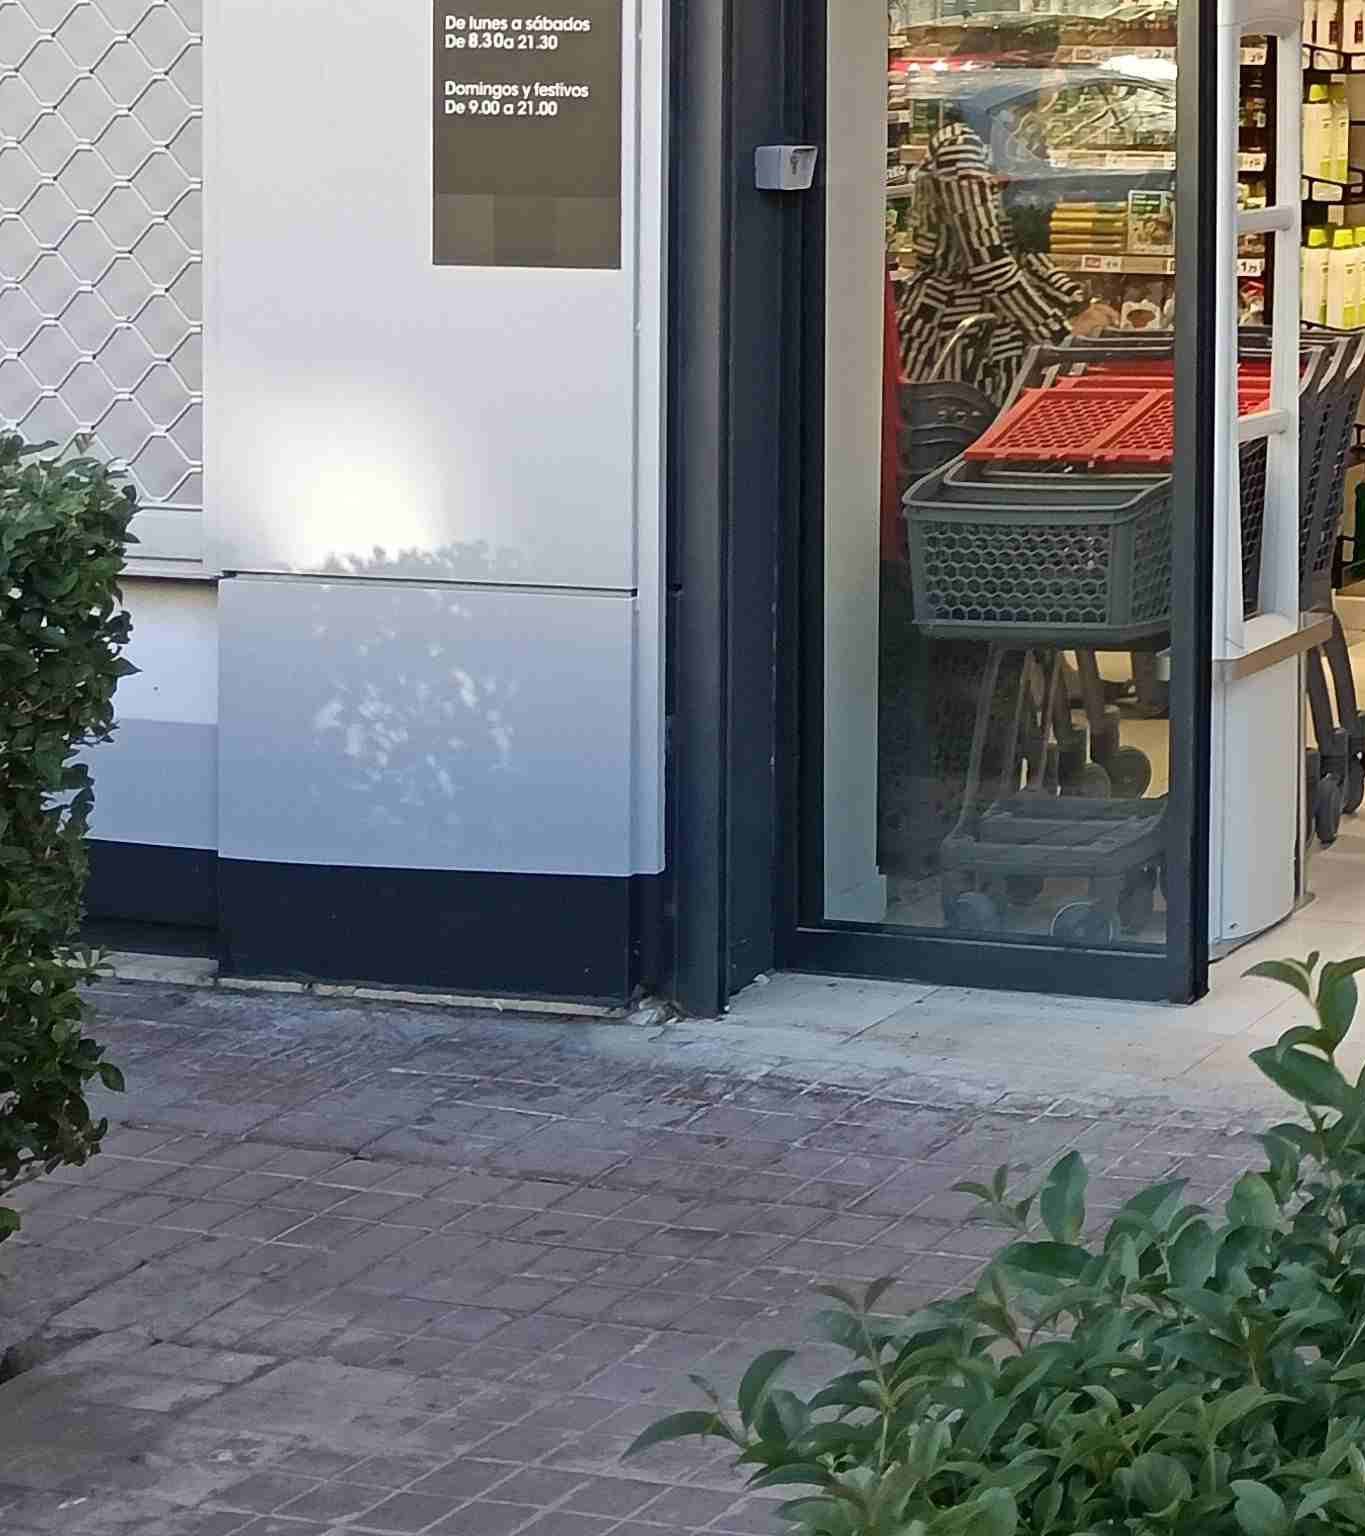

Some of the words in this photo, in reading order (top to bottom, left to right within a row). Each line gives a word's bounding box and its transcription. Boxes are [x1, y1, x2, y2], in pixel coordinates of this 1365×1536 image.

[445, 15, 466, 31] De
[468, 15, 508, 31] lunes
[511, 18, 522, 31] a
[525, 15, 591, 31] sábados
[445, 34, 466, 49] De
[517, 34, 559, 50] 21.30
[444, 80, 519, 99] Domingos
[522, 85, 531, 99] y
[533, 82, 589, 98] festivos
[444, 99, 466, 114] De
[468, 100, 500, 115] 9.00
[503, 103, 514, 115] a
[516, 100, 558, 116] 21.00
